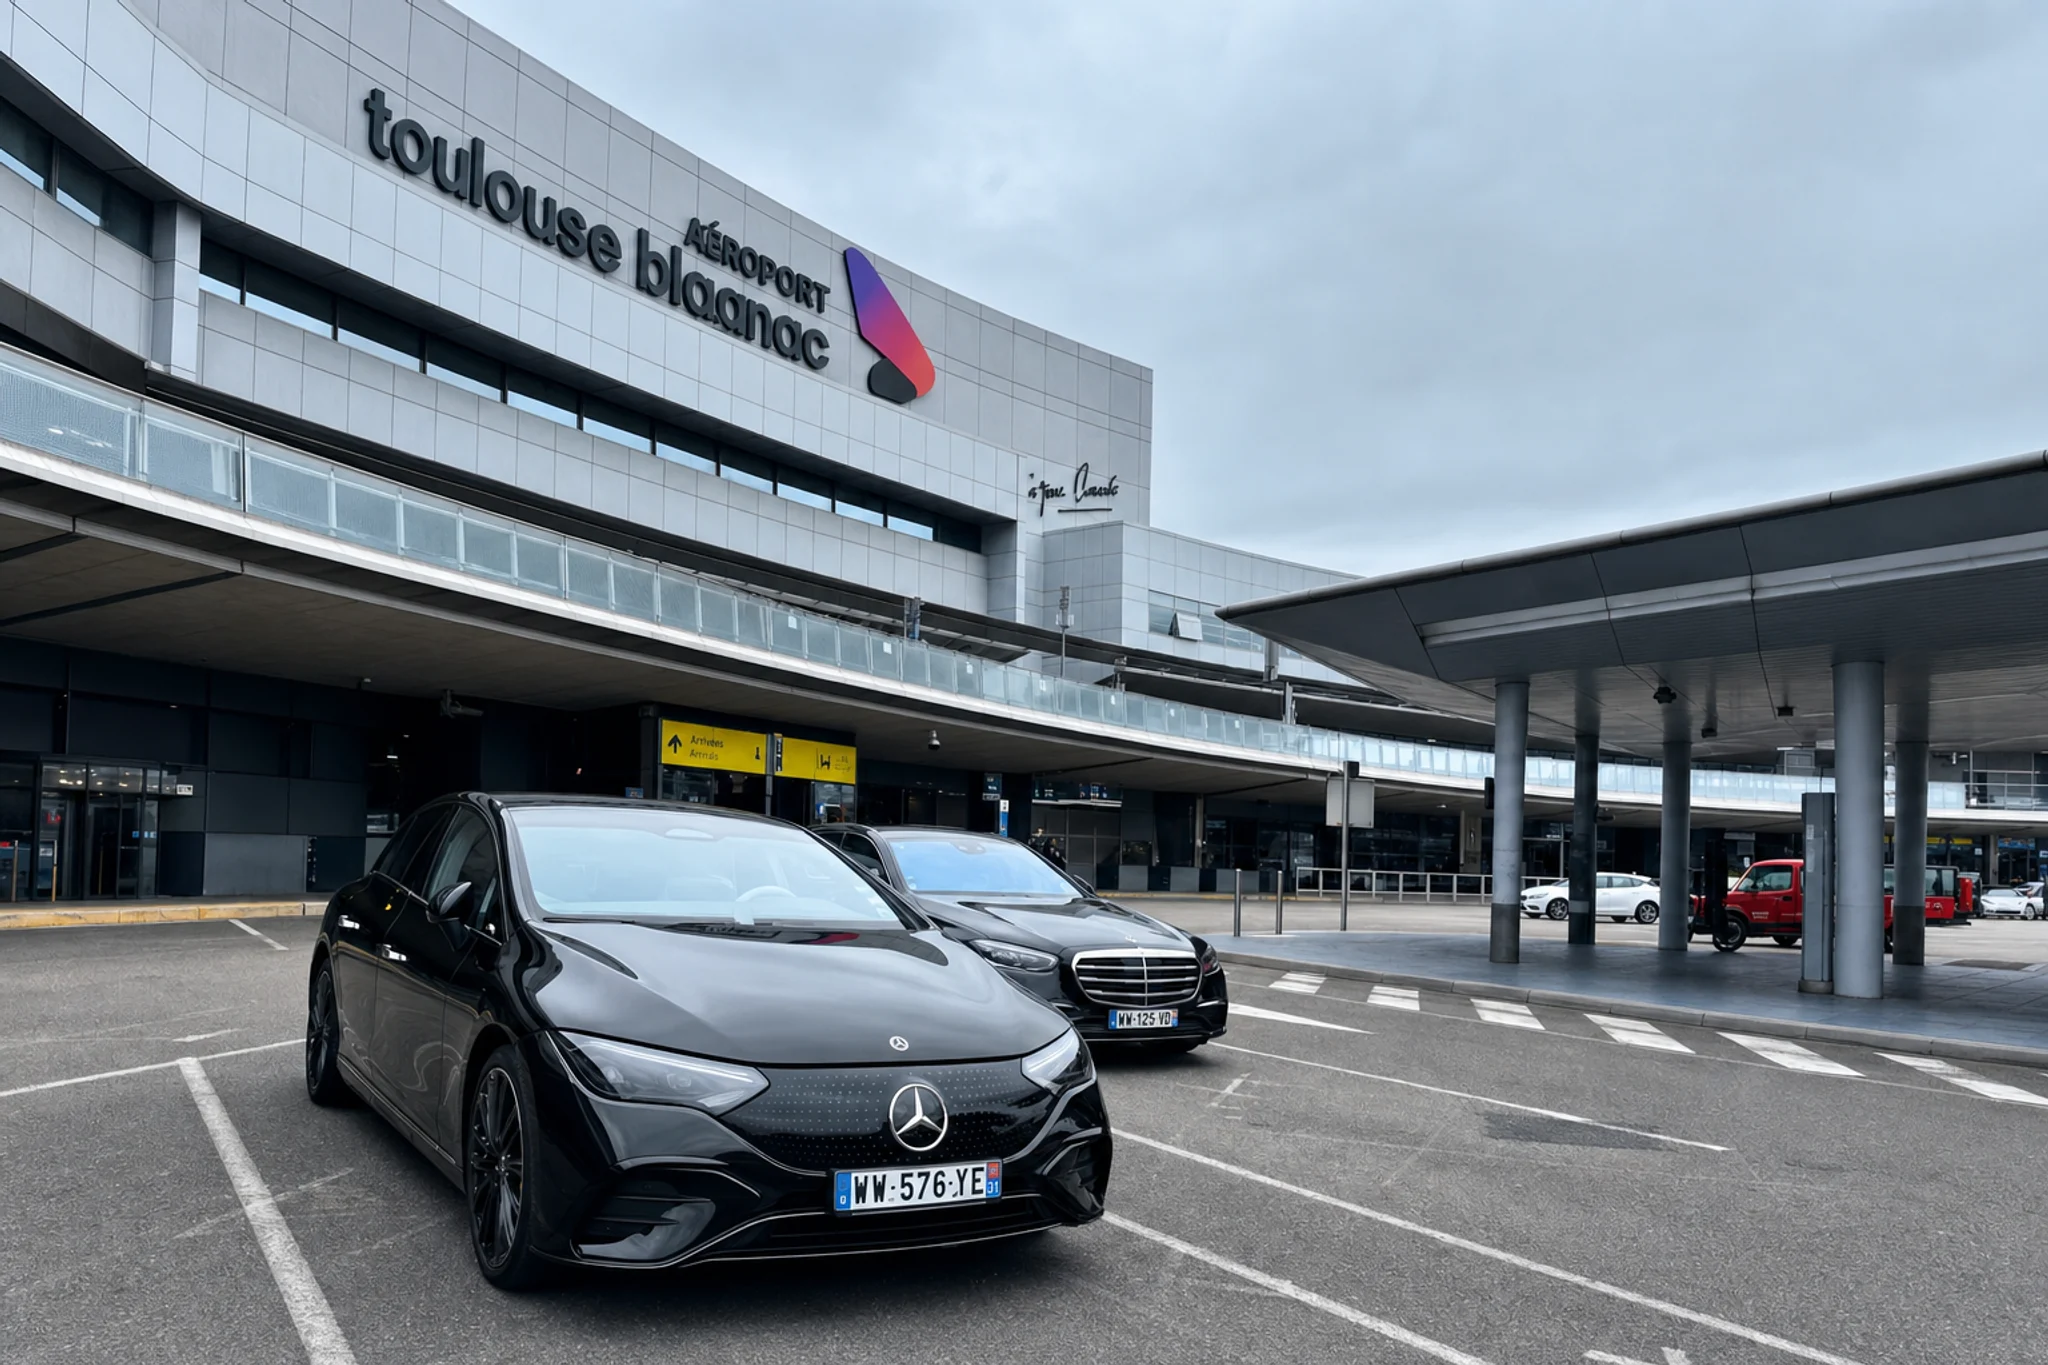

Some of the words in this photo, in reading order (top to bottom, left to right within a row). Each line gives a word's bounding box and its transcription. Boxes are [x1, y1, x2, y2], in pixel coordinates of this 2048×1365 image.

[364, 88, 622, 273] toulouse
[635, 227, 830, 370] blaanac
[684, 217, 831, 313] AÉROPORT
